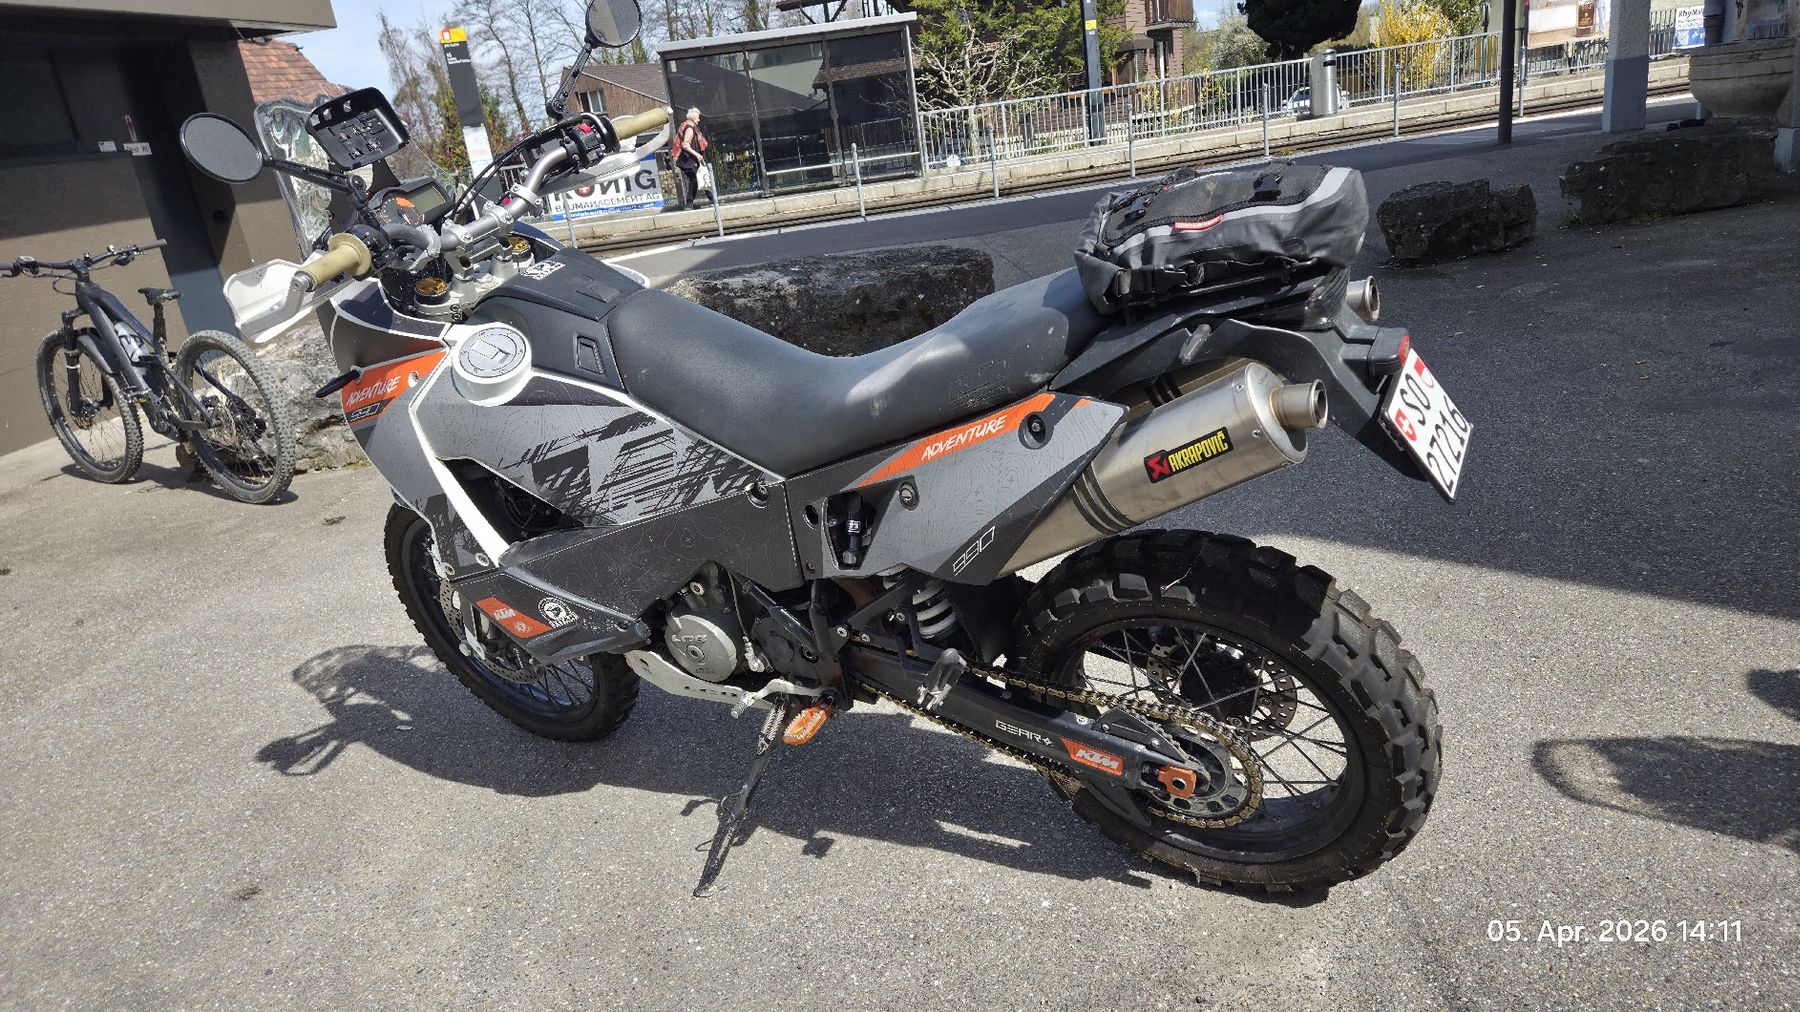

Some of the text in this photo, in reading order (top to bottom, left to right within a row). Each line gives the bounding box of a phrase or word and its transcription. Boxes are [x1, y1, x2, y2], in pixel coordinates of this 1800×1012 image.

[645, 192, 660, 201] AG
[346, 376, 401, 407] ADVENTURE
[1400, 373, 1431, 426] SO
[921, 414, 1008, 460] ADVENTURE
[1426, 395, 1468, 494] 27216
[953, 525, 996, 577] 990
[1075, 748, 1120, 770] KTM
